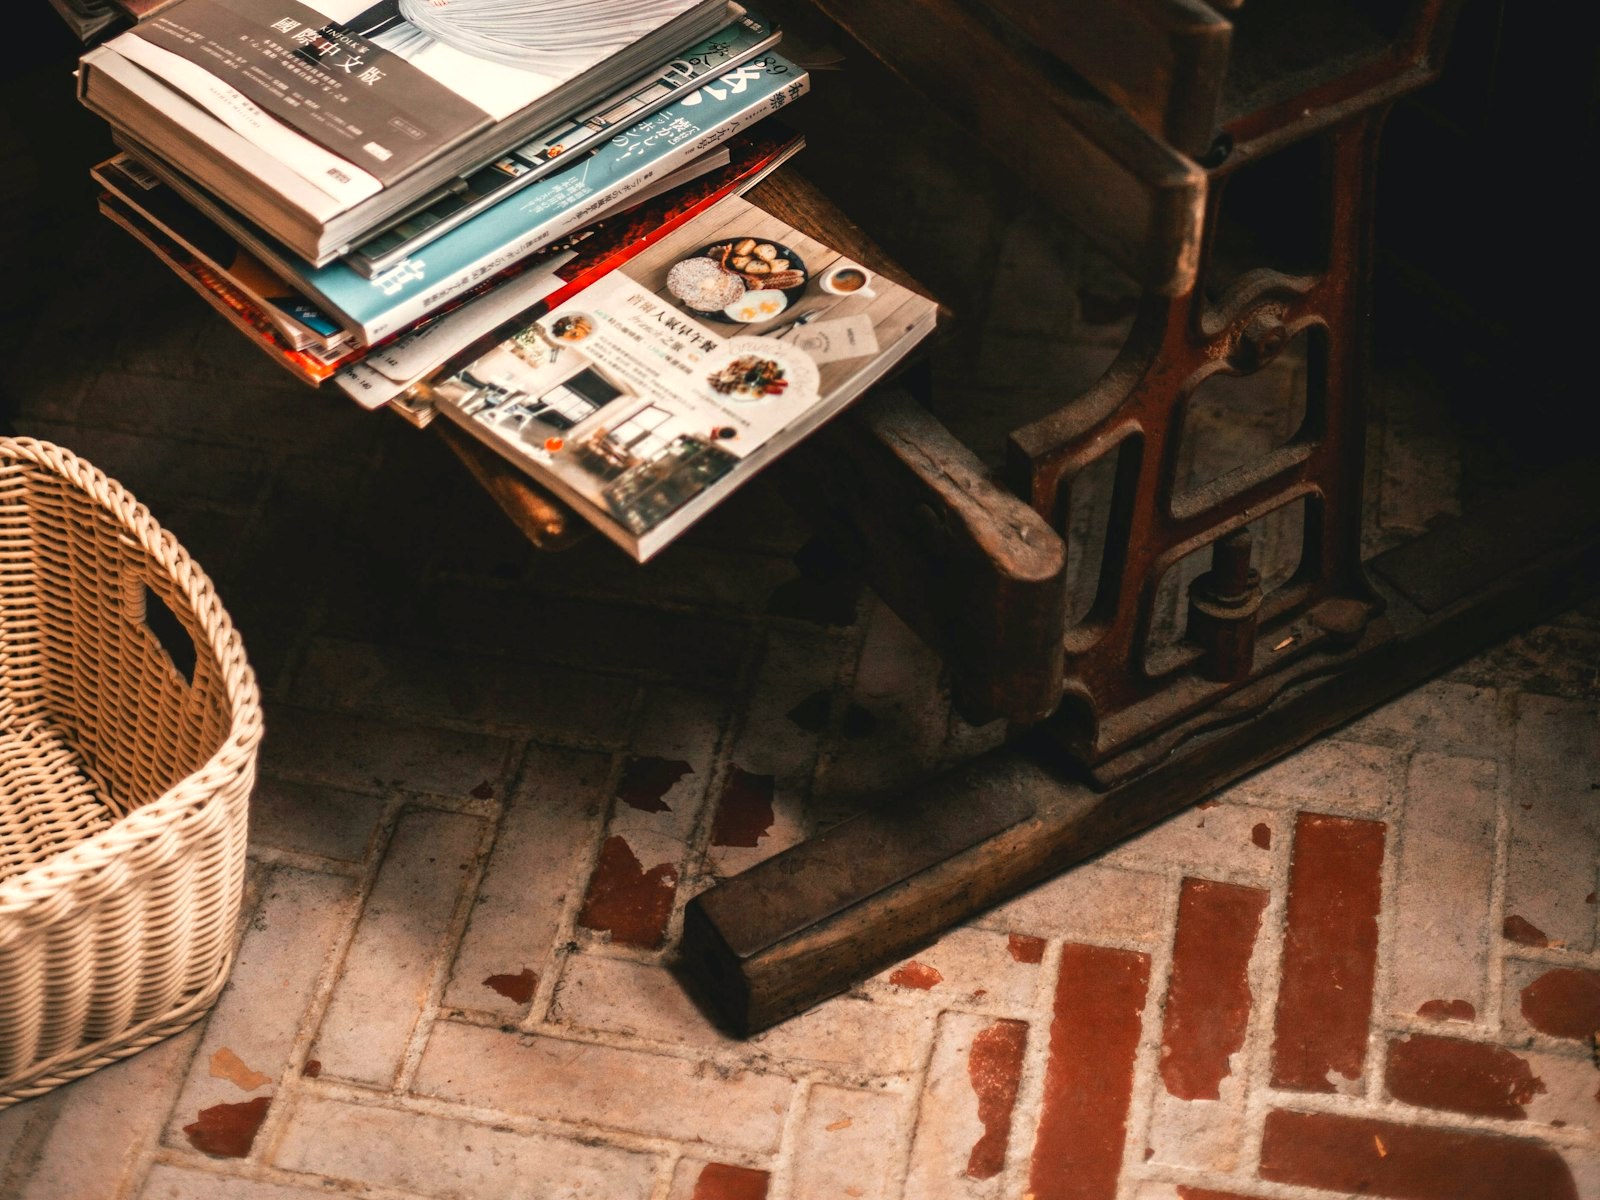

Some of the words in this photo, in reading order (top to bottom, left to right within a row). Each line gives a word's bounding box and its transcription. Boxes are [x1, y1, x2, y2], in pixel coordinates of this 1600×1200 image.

[270, 16, 387, 86] 國際中文版
[612, 111, 673, 147] ニッポンの
